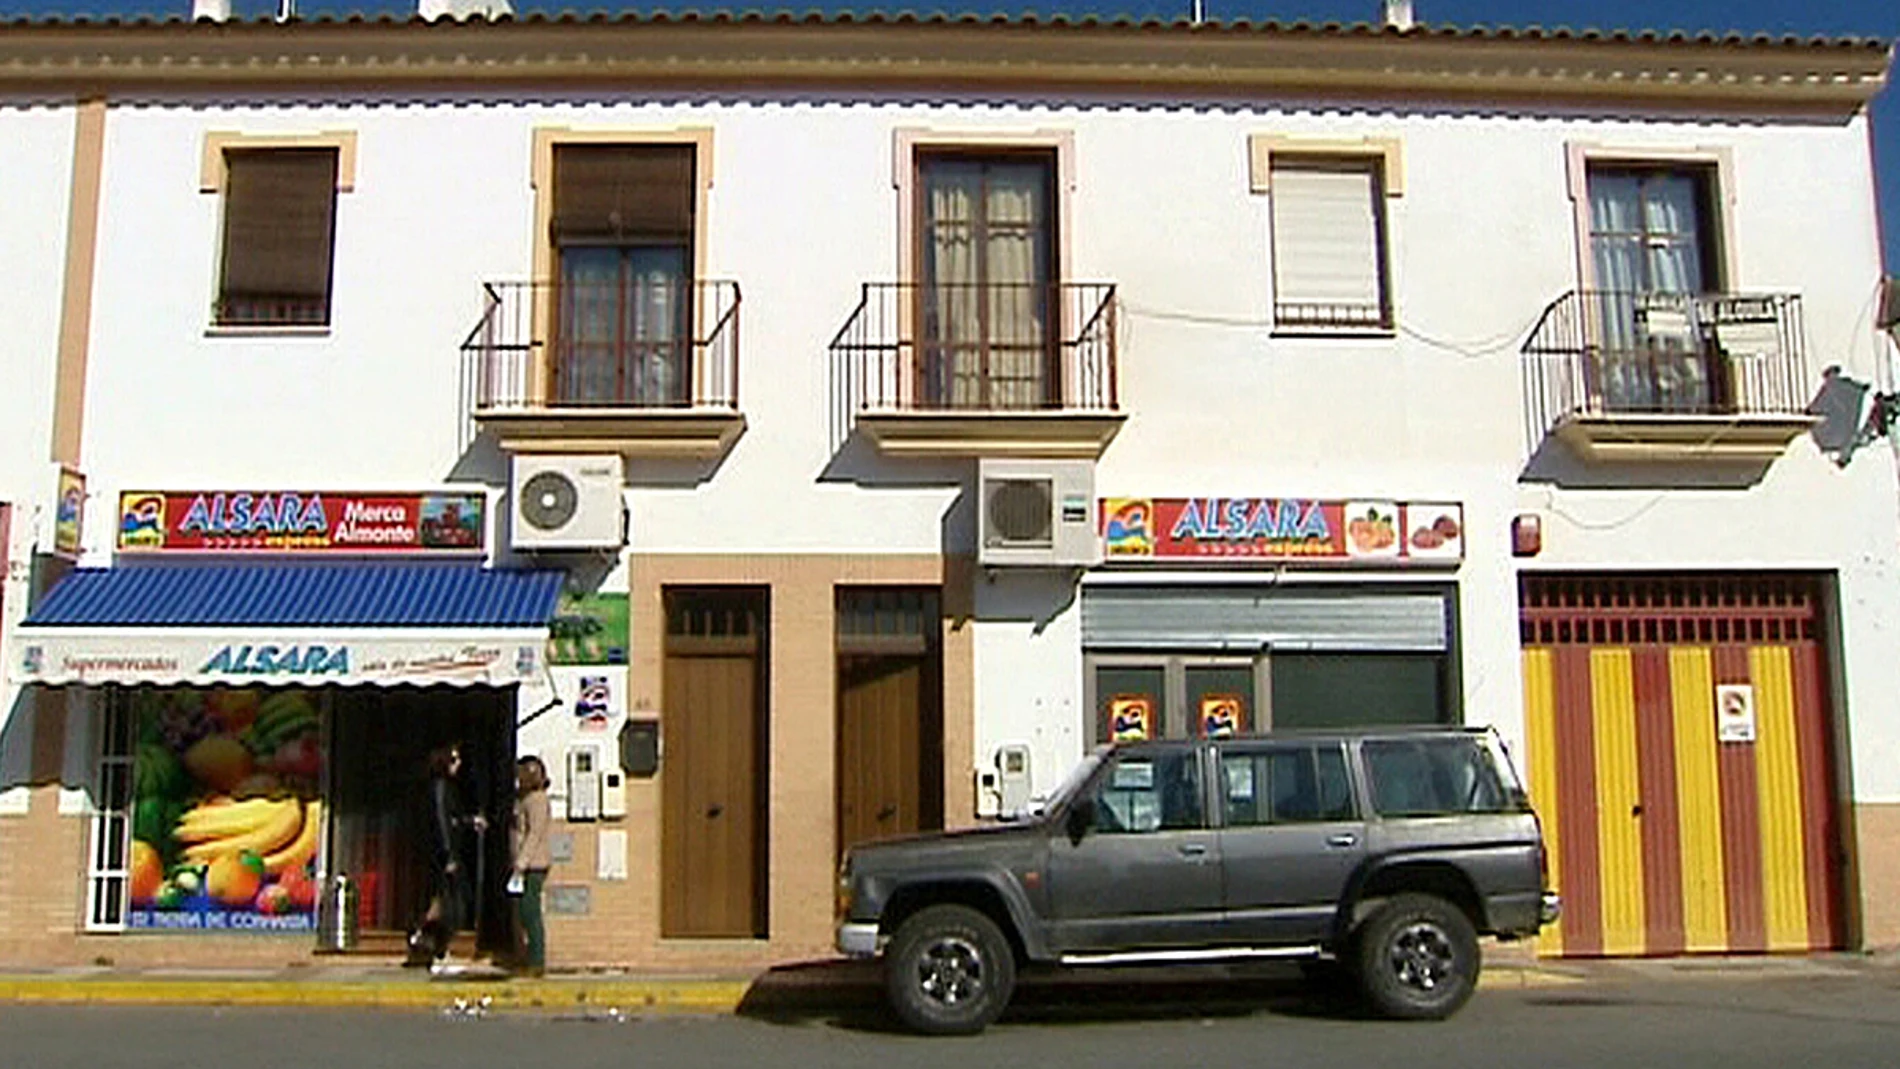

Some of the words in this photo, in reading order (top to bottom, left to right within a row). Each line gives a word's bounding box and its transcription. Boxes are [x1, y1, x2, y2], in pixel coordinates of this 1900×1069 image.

[178, 493, 328, 533] ALSARA
[344, 502, 406, 523] Merca
[1171, 498, 1330, 538] ALSARA
[334, 522, 416, 544] Almonte
[62, 653, 179, 678] Supermercados
[198, 644, 349, 675] ALSARA
[205, 911, 227, 928] DE
